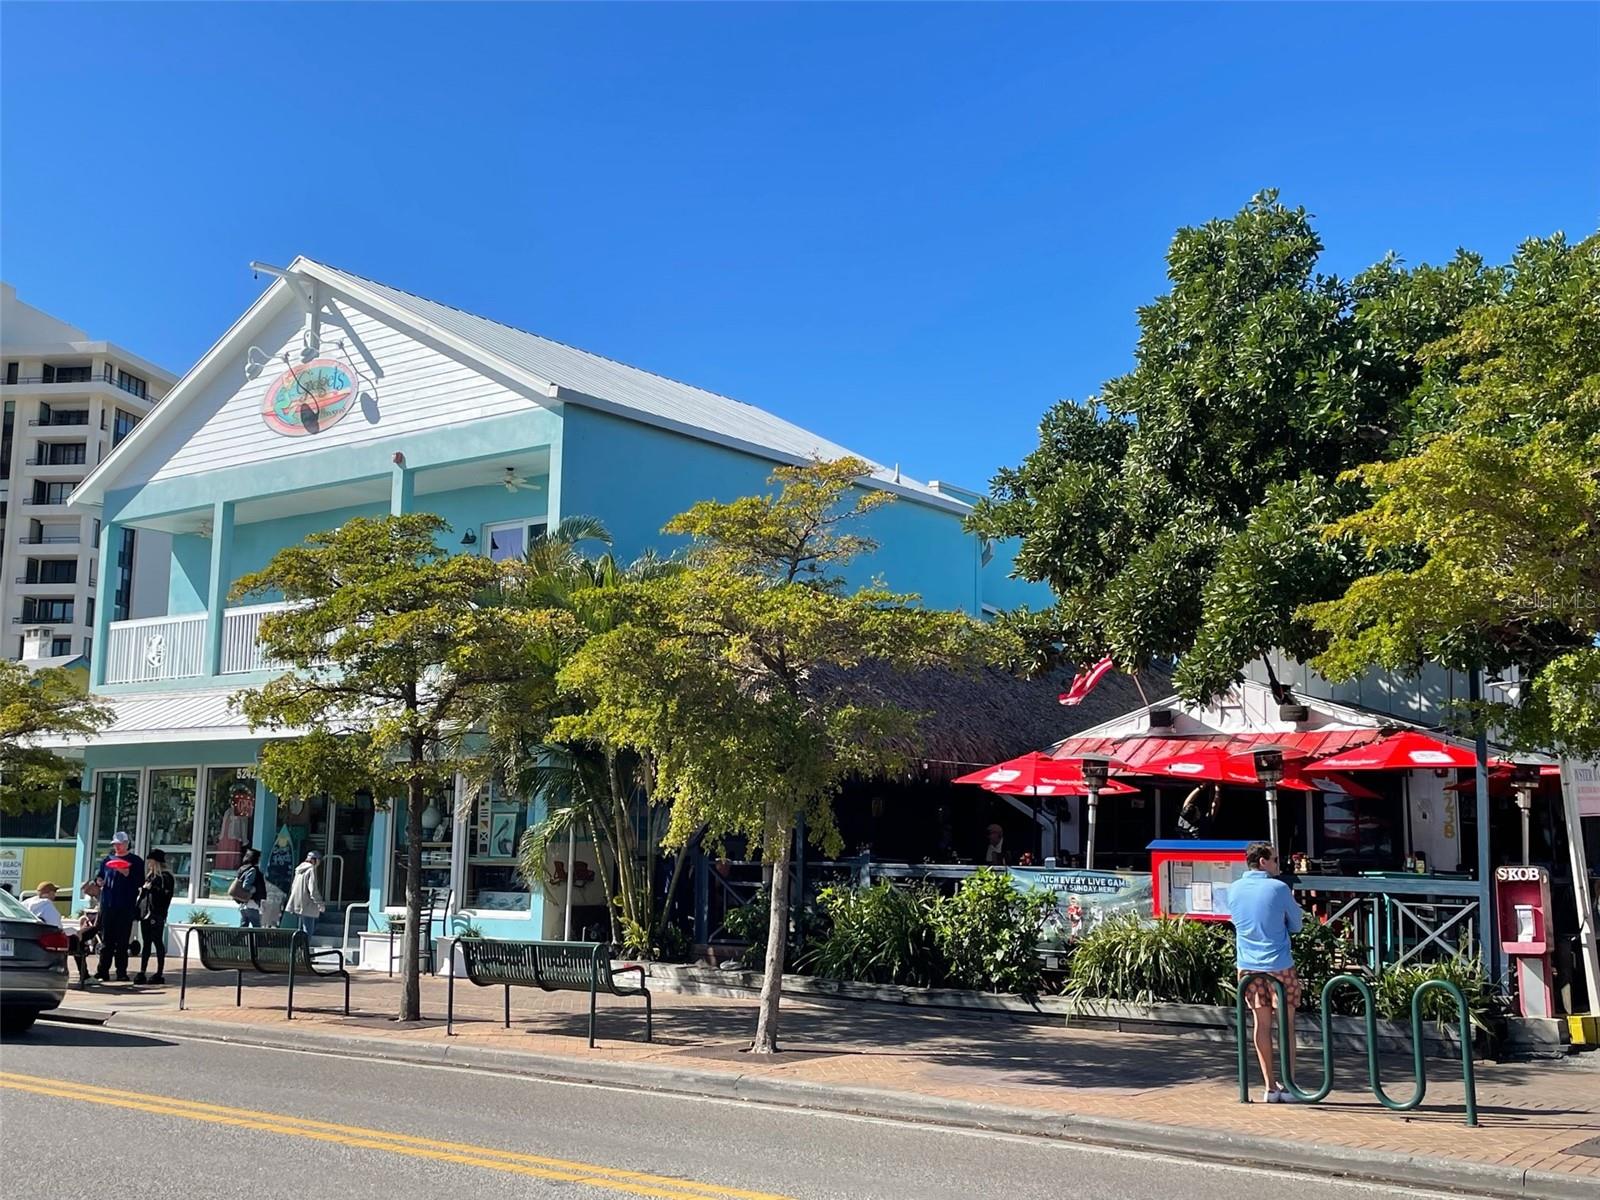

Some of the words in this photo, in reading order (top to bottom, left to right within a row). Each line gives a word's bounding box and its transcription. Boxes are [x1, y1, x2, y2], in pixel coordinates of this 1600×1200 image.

[1033, 875, 1059, 884] WATCH
[1060, 876, 1086, 885] EVERY
[1088, 877, 1106, 886] LIVE
[1497, 868, 1540, 881] SKOB
